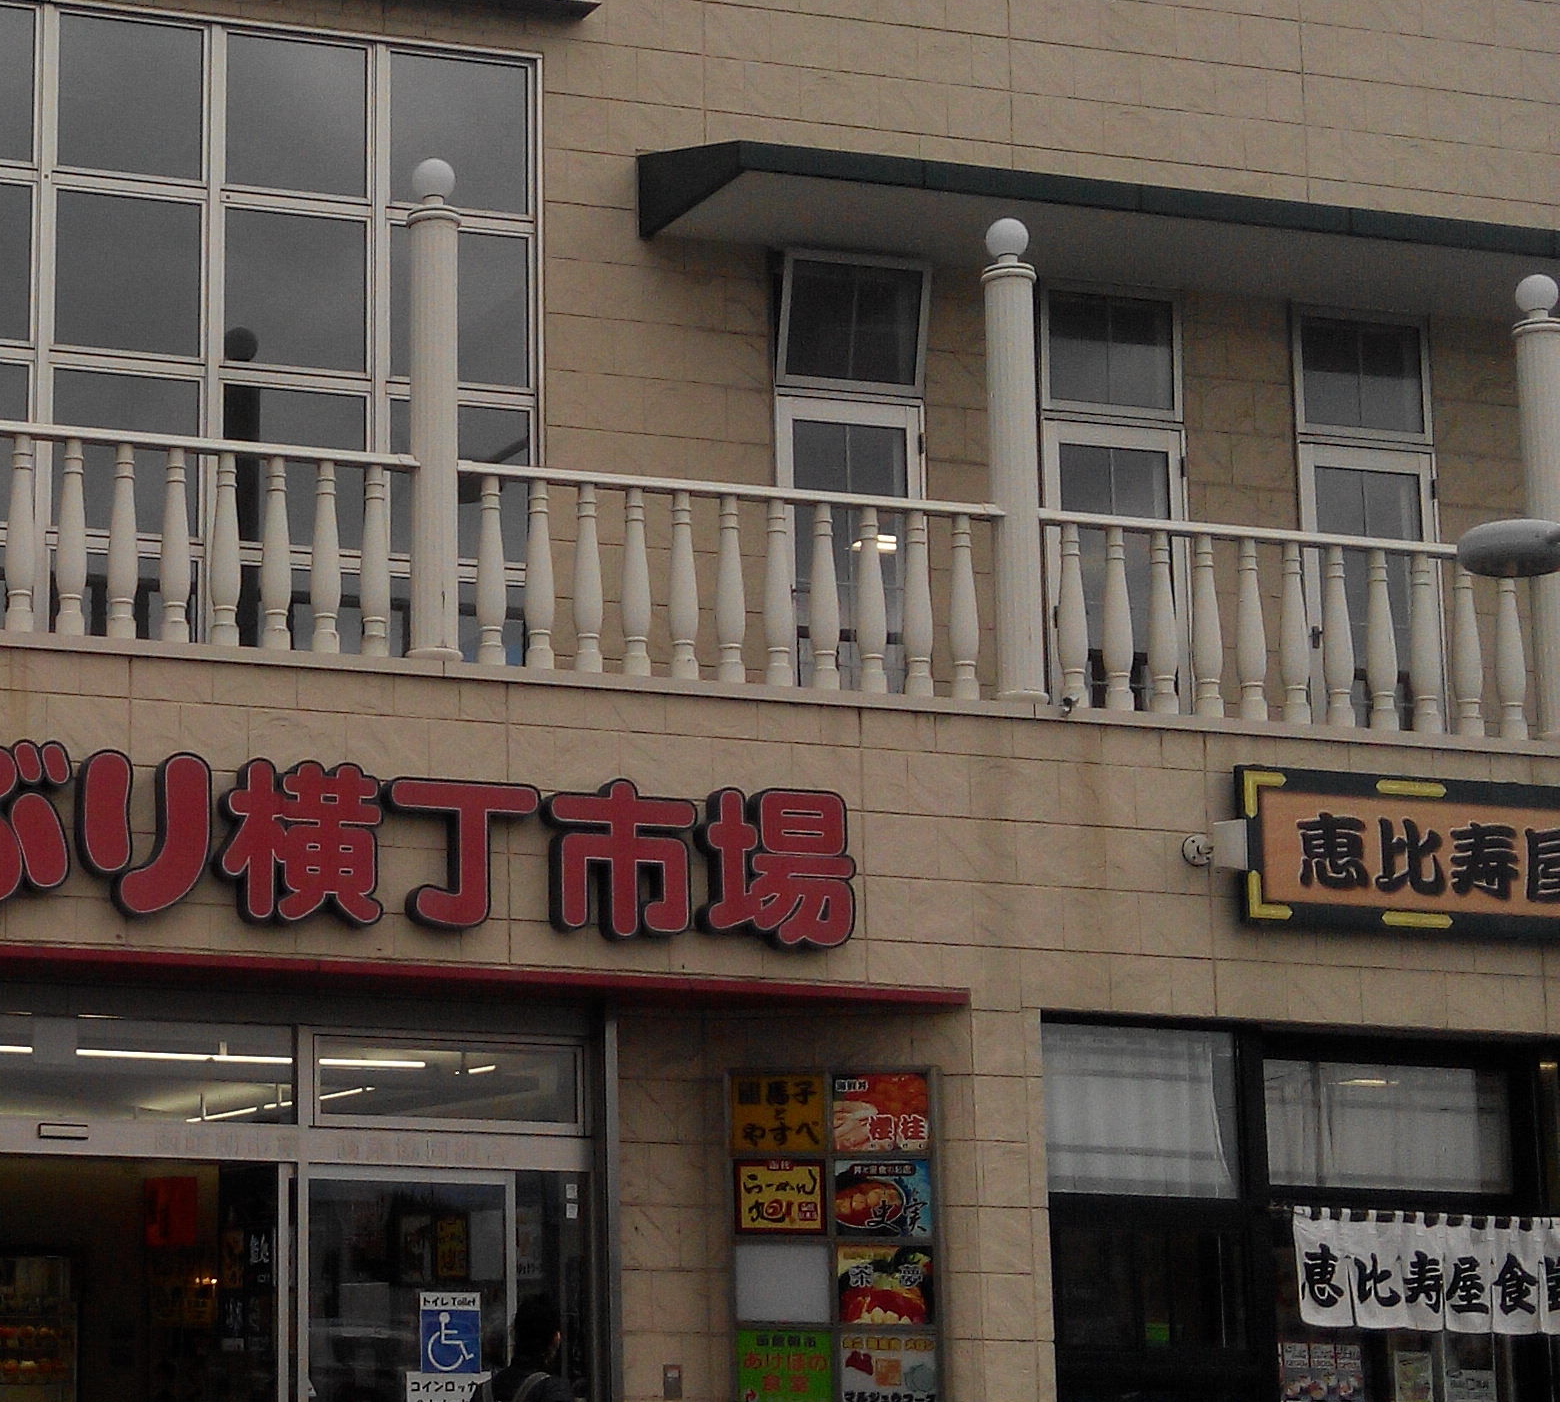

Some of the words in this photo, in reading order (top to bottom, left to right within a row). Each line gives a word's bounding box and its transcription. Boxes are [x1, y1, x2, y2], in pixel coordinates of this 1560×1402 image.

[423, 1297, 449, 1306] トイレ
[451, 1297, 476, 1306] Toilet
[410, 1380, 483, 1392] コインロッカ
